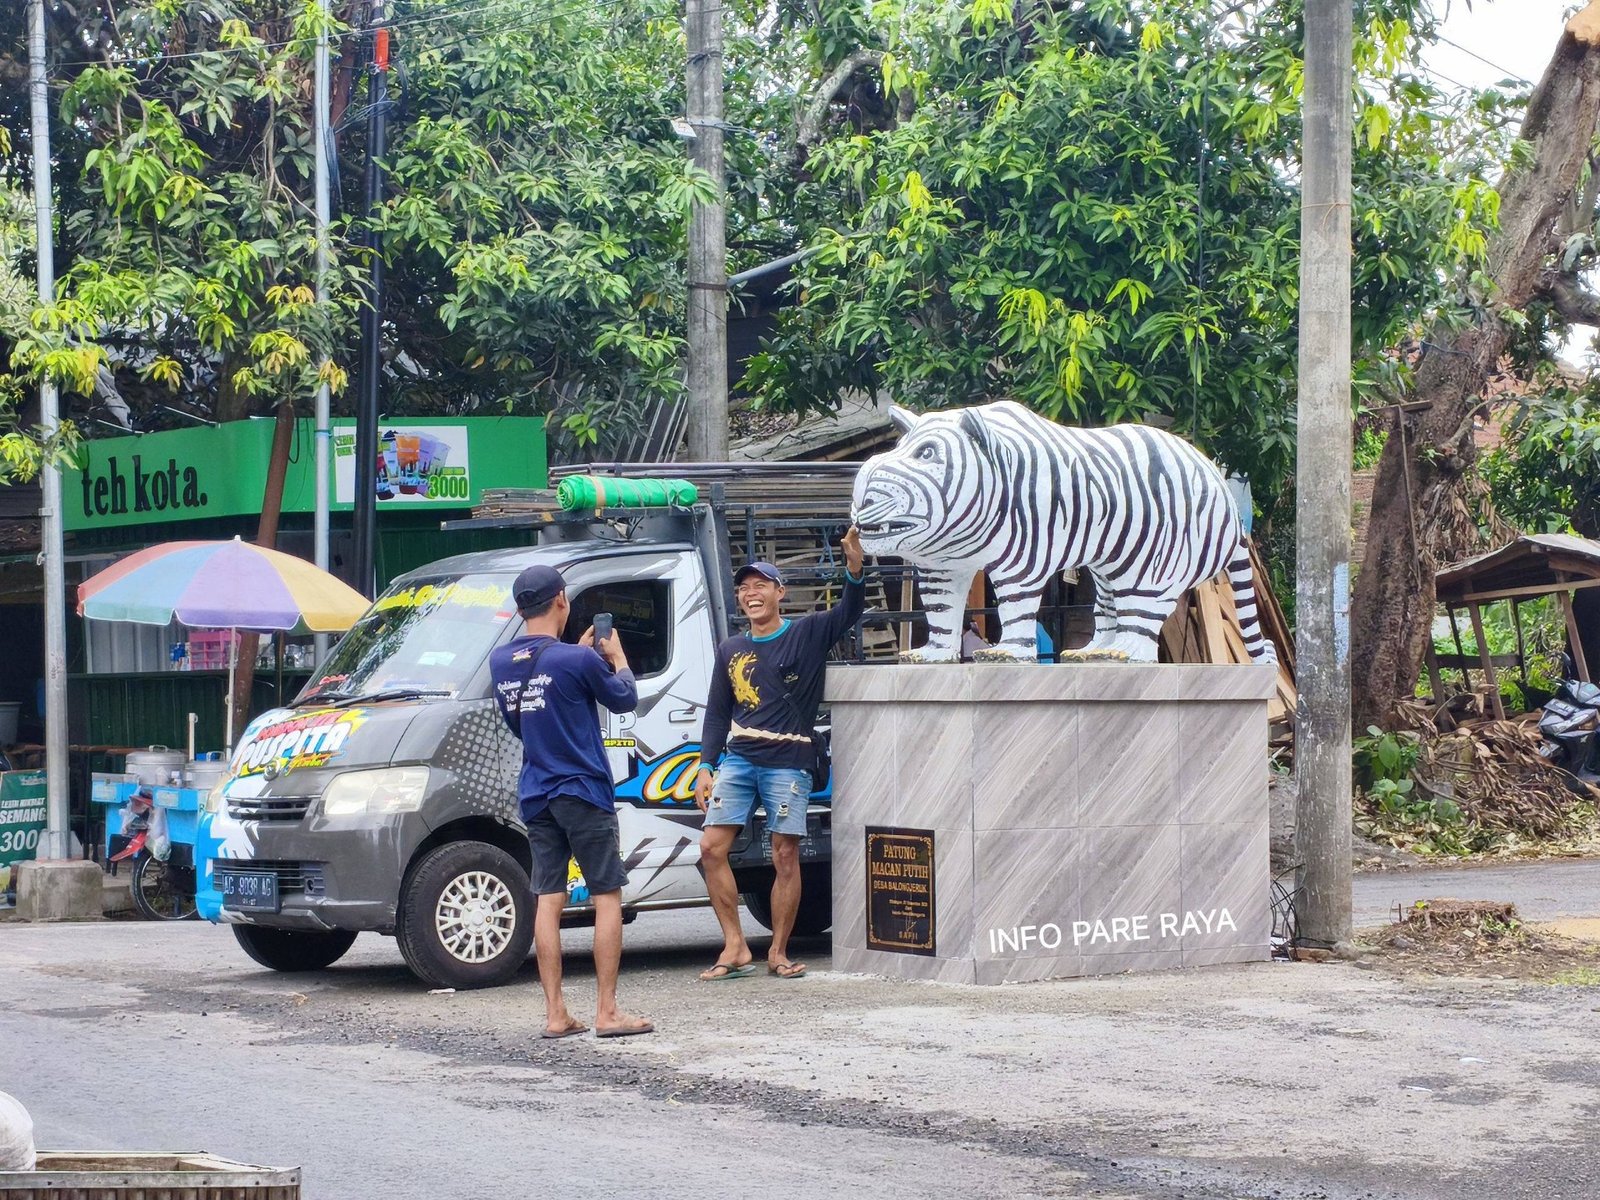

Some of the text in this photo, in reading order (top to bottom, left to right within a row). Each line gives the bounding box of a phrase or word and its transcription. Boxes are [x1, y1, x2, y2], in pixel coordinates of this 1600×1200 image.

[81, 454, 208, 518] teh kota.
[429, 475, 469, 499] 3000
[235, 721, 353, 777] PUSPITA
[883, 844, 917, 860] PATUNG
[872, 861, 929, 879] MACAN PUTIH
[873, 880, 888, 890] DESA
